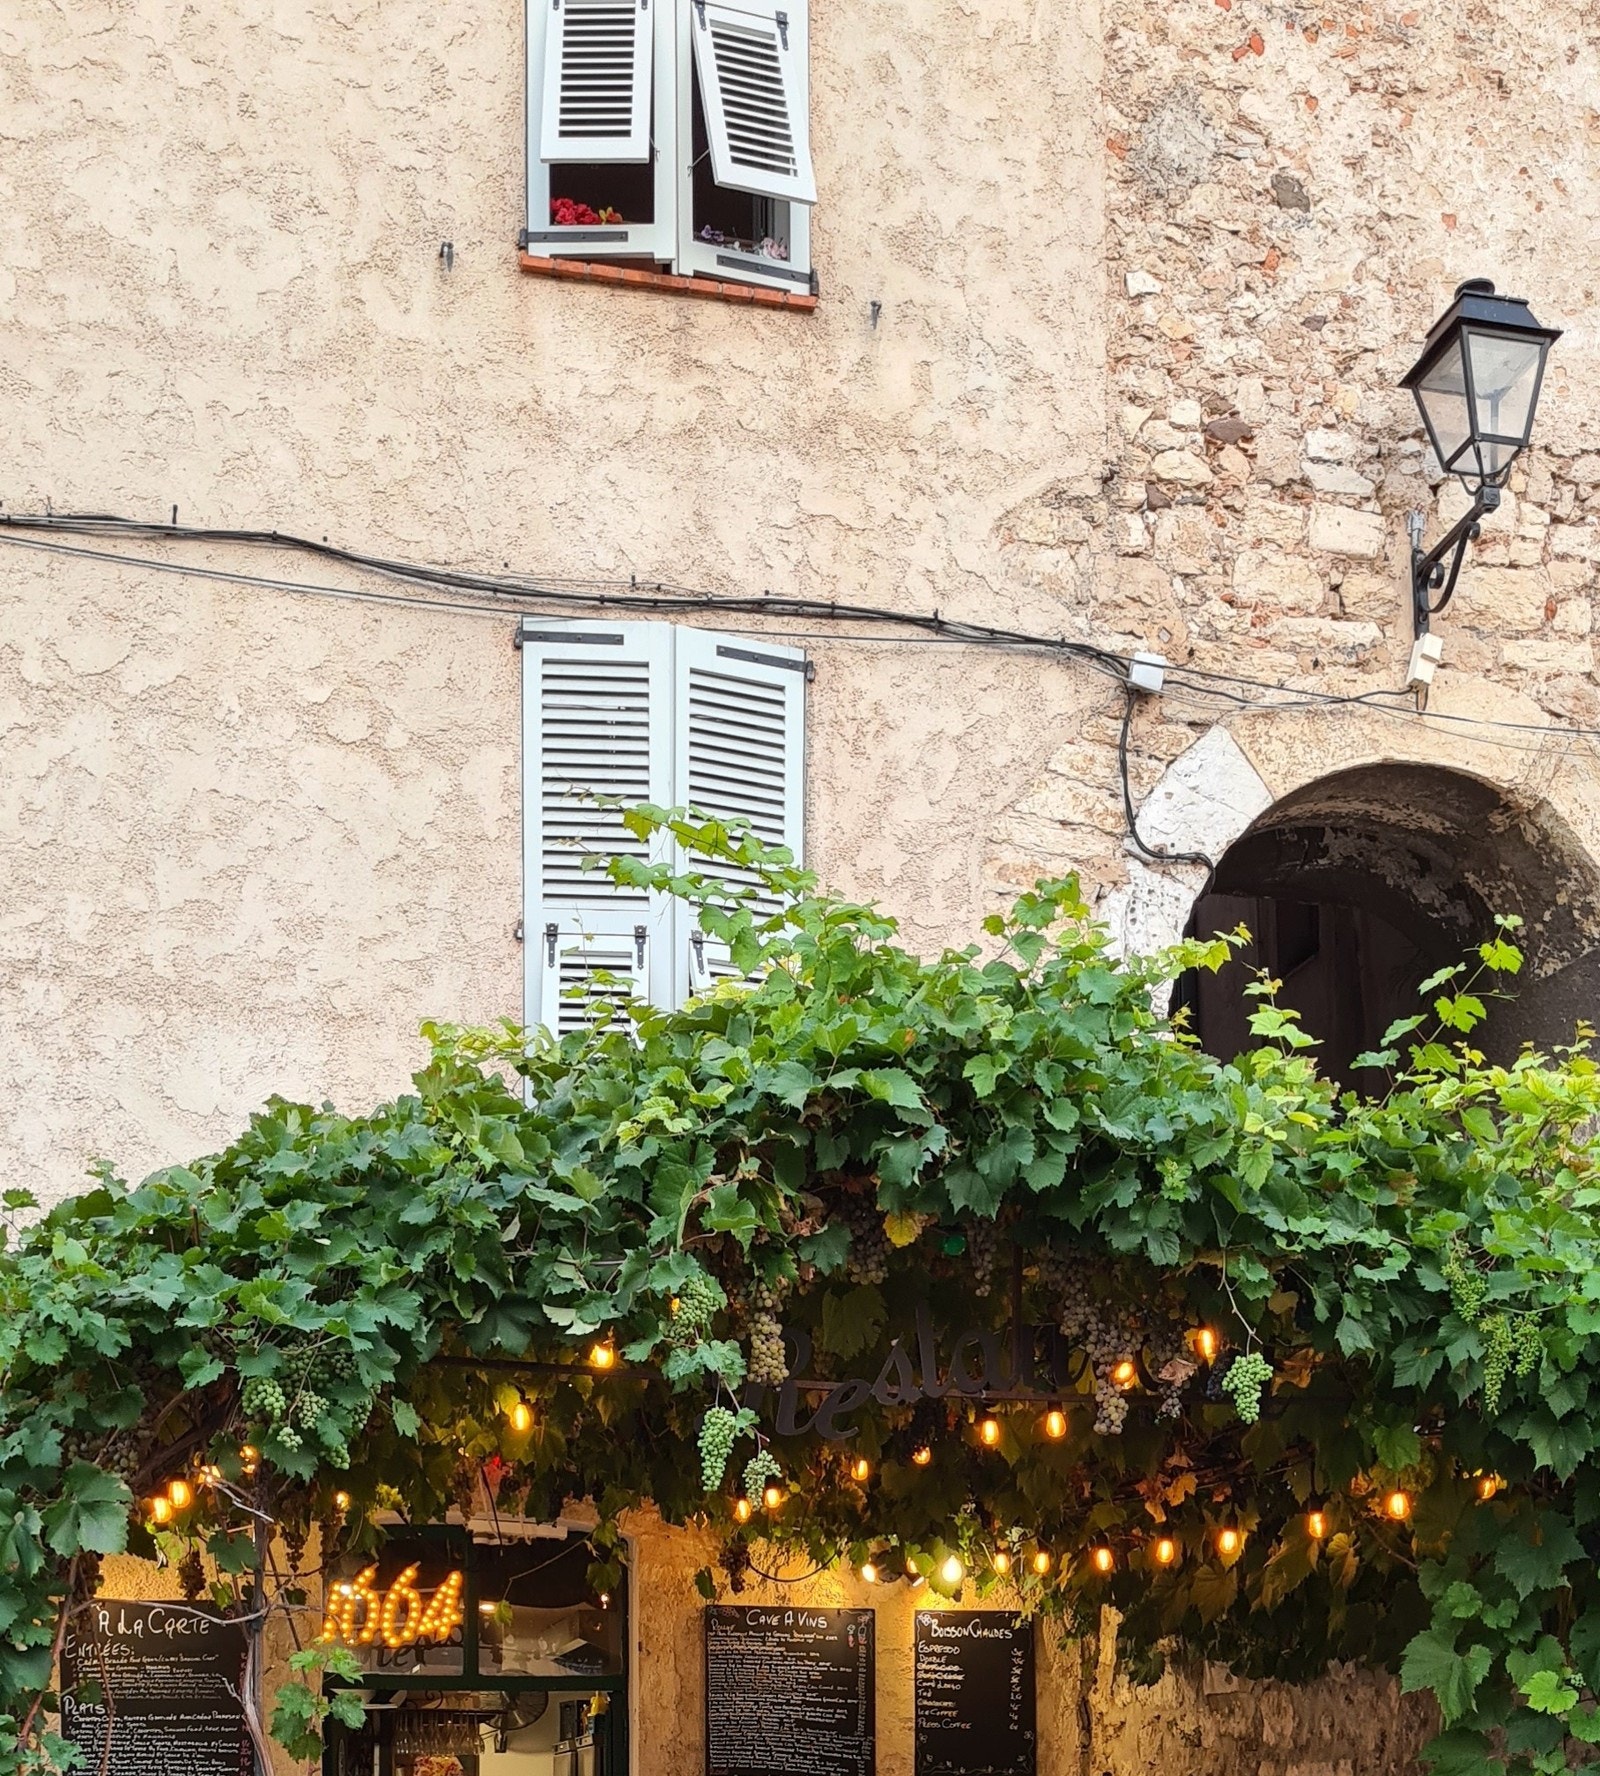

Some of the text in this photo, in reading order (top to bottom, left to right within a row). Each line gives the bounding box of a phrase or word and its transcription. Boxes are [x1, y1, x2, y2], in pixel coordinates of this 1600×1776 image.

[148, 1608, 210, 1639] CARTE
[746, 1609, 781, 1626] CAVE
[797, 1611, 828, 1629] VINS
